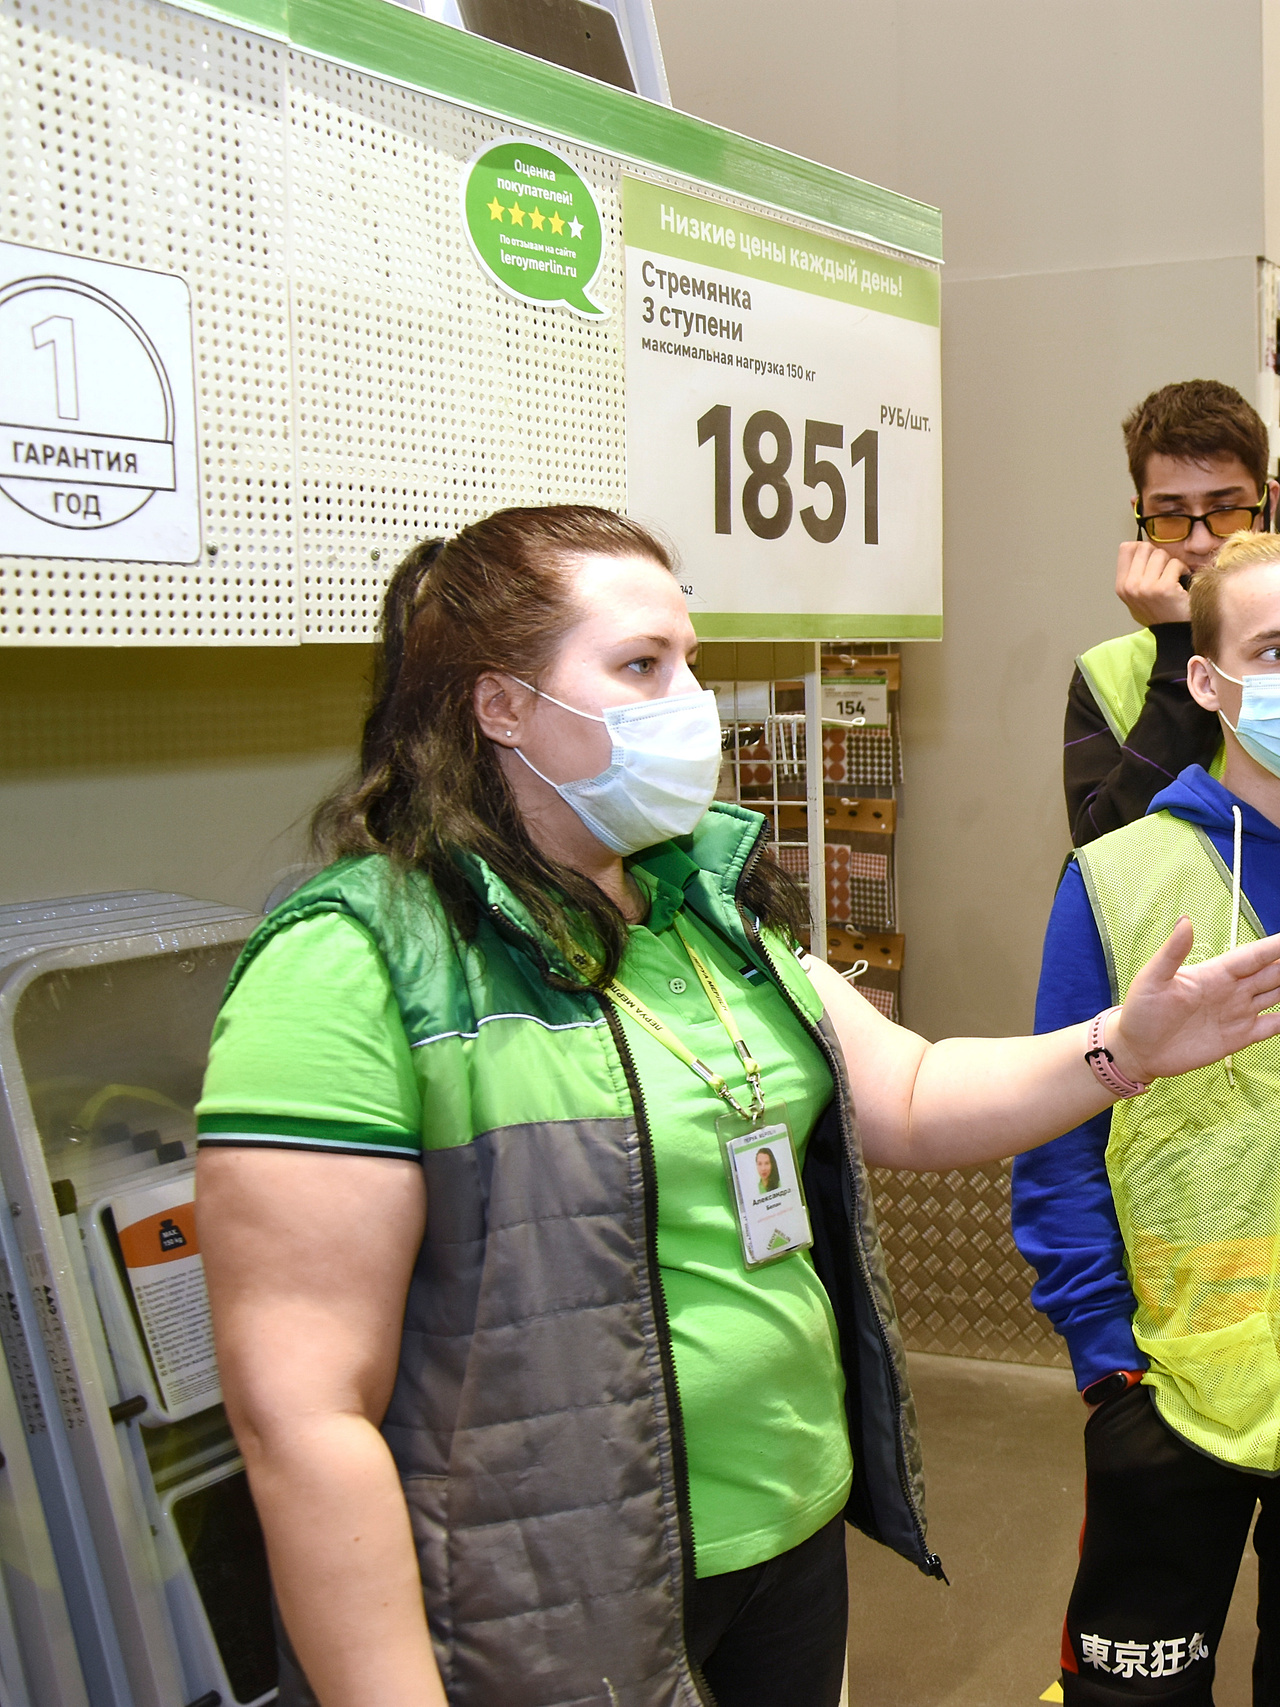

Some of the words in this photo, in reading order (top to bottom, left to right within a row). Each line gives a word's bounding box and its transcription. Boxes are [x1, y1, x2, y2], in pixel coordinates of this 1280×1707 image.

[514, 159, 556, 182] Оценка
[497, 177, 573, 206] покупателей!
[500, 233, 511, 245] По
[511, 238, 544, 252] отзывам
[545, 244, 554, 254] на
[555, 246, 577, 259] сайте
[660, 203, 736, 250] Низкие
[739, 232, 786, 265] цены
[790, 247, 858, 285] каждый
[860, 270, 903, 298] день!
[500, 249, 577, 278] leroymerlin.ru
[641, 260, 752, 311] Стремянка
[642, 297, 655, 324] 3
[659, 304, 744, 343] ступени
[31, 314, 79, 421] 1
[641, 336, 734, 367] максимальная
[735, 354, 785, 377] нагрузка
[786, 363, 804, 381] 150
[805, 369, 817, 382] кг
[12, 440, 139, 474] ГАРАНТИЯ
[697, 404, 879, 545] 1851
[53, 491, 102, 521] ГОД
[836, 700, 866, 715] 154
[609, 982, 636, 1008] МЕРЛЕ
[635, 1007, 663, 1032] ЛЕРУА
[752, 1187, 792, 1207] Александра
[1080, 1632, 1209, 1679] 東京狂気
